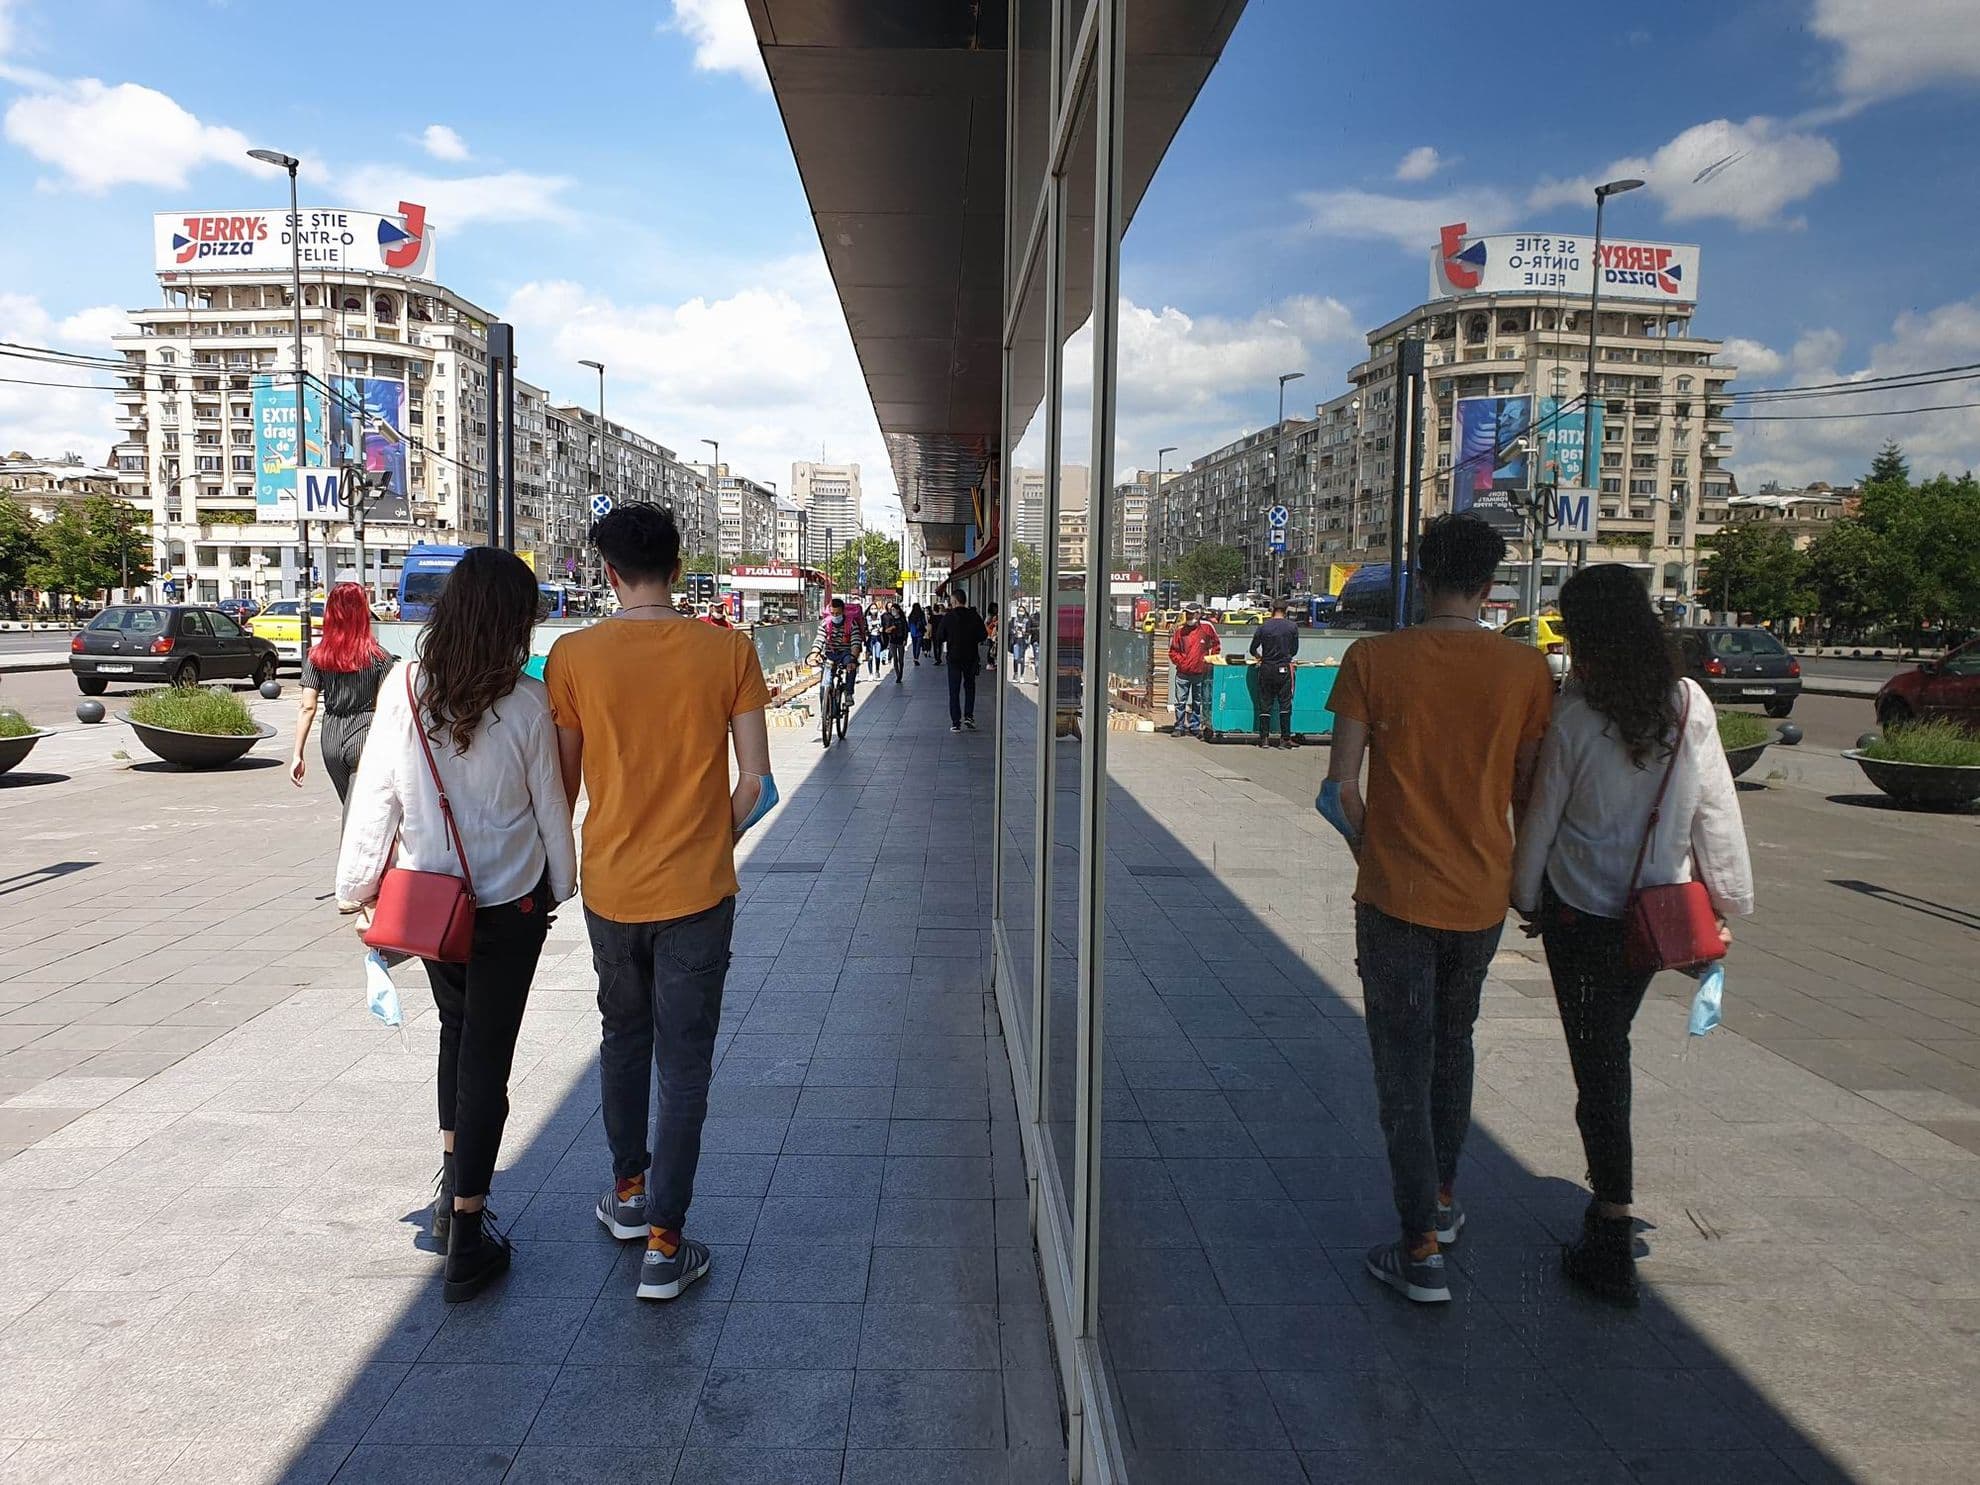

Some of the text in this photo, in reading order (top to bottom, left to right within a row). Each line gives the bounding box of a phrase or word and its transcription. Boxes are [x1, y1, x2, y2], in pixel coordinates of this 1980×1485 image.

[285, 214, 303, 227] SE
[281, 231, 354, 245] DNTR-O
[198, 241, 254, 258] pizza
[306, 475, 338, 512] M
